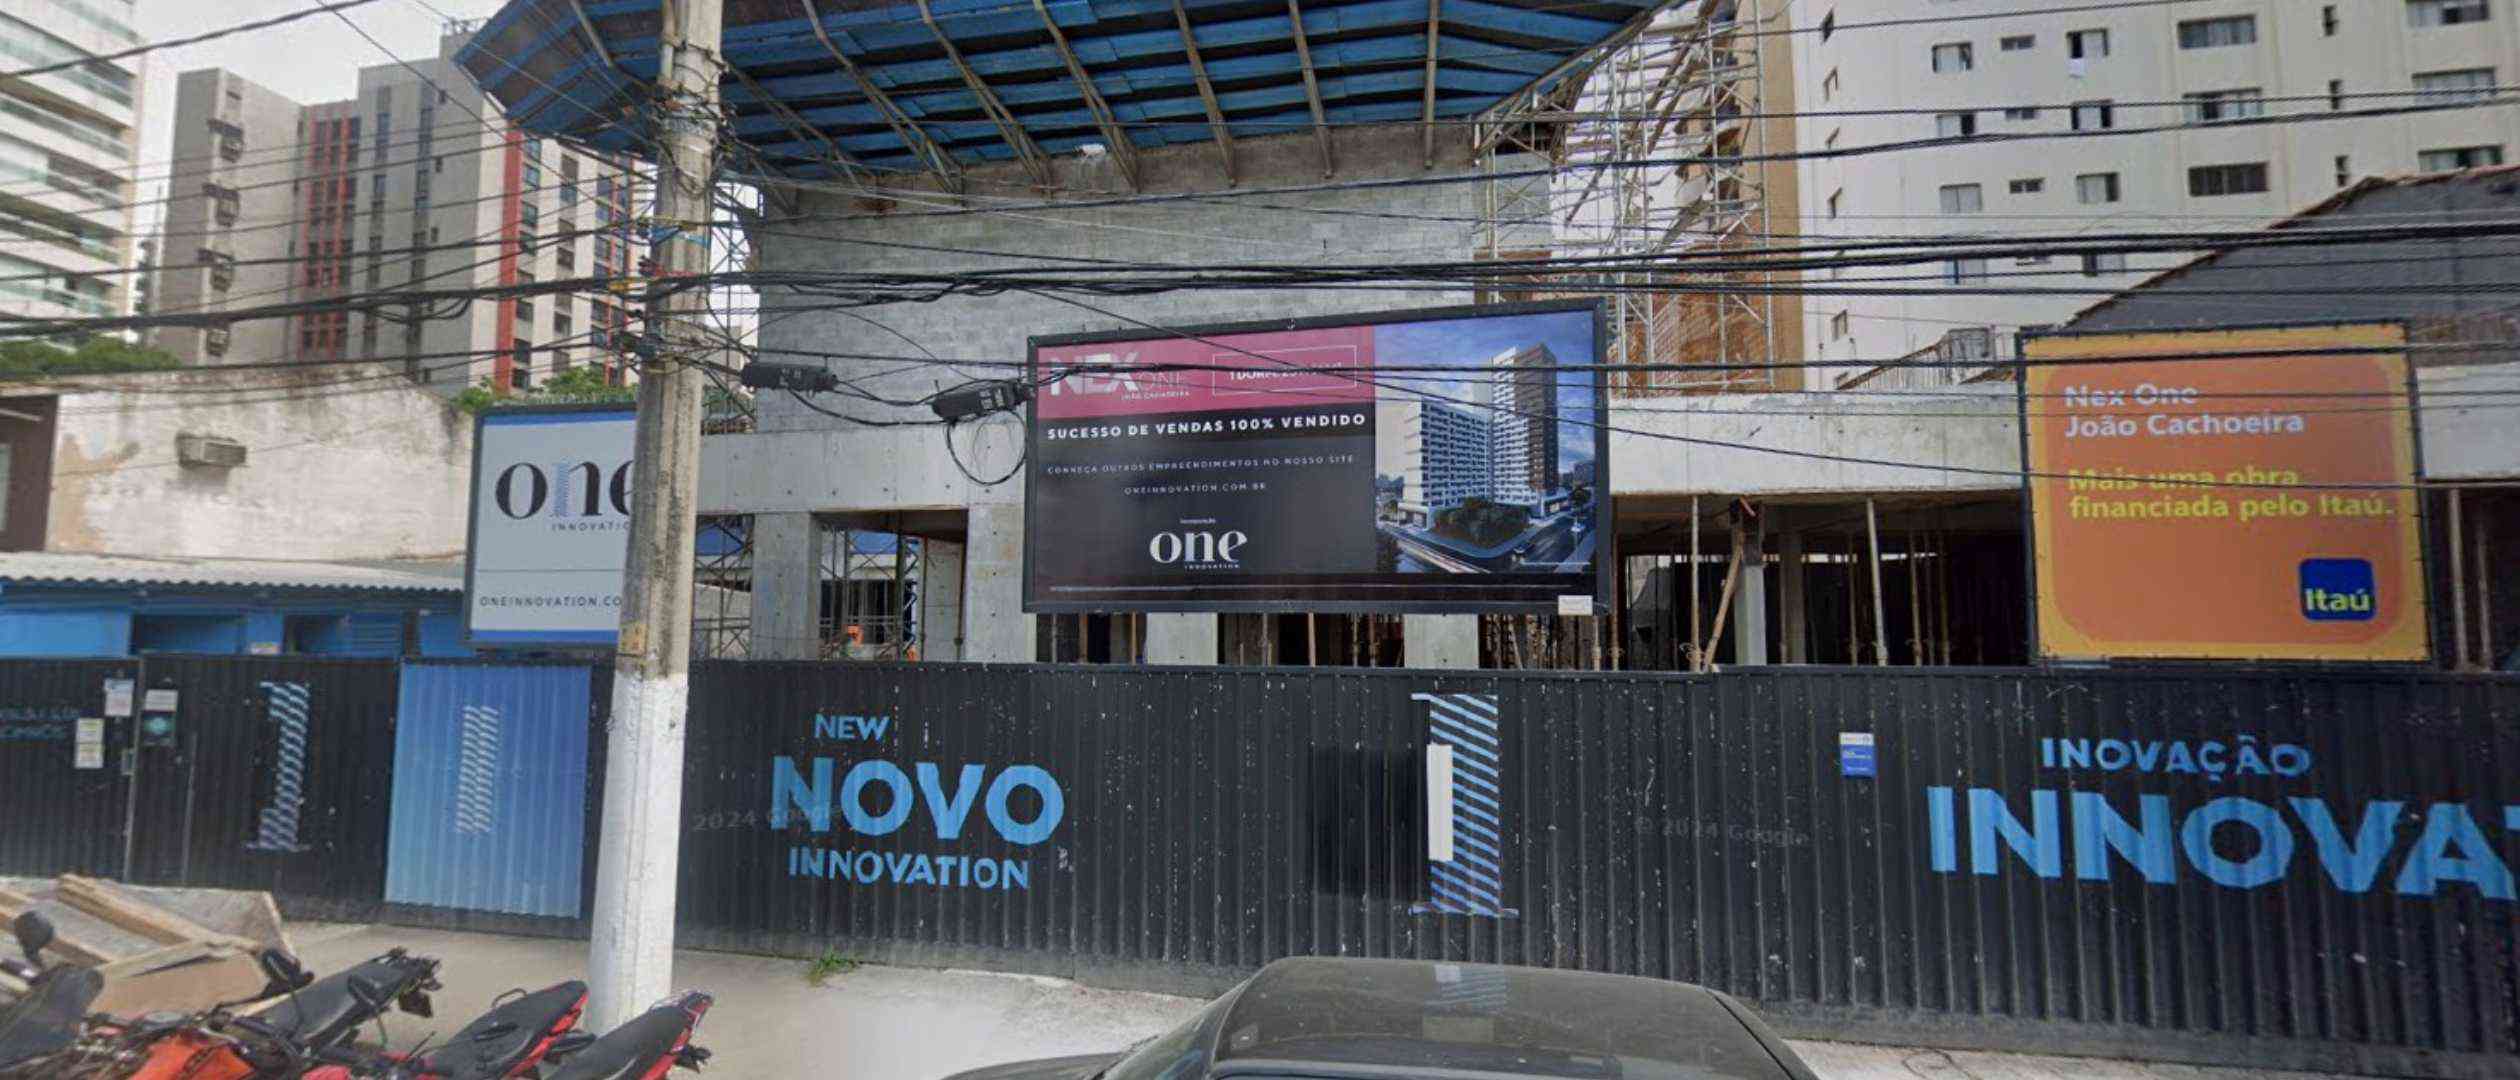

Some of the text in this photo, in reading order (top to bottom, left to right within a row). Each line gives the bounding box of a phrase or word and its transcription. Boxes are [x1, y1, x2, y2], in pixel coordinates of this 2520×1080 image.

[2065, 383, 2199, 407] Nex One
[1047, 413, 1366, 440] SUCESSO DE VENDAS 100% VENDIDO
[2065, 411, 2305, 438] João Cachoeira
[2069, 465, 2299, 491] Mais uma obra
[2070, 490, 2394, 522] financiada pelo Itaú.
[552, 521, 629, 532] INNOVATIO
[1149, 531, 1248, 563] one
[480, 596, 622, 607] ONEINNOVATION.CO
[2305, 587, 2371, 612] Itaú
[814, 713, 890, 742] NEW
[2041, 734, 2313, 781] INOVAÇÃO
[770, 755, 1065, 846] NOVO
[1927, 785, 2520, 900] INNOVA
[788, 847, 1030, 889] INNOVATION
